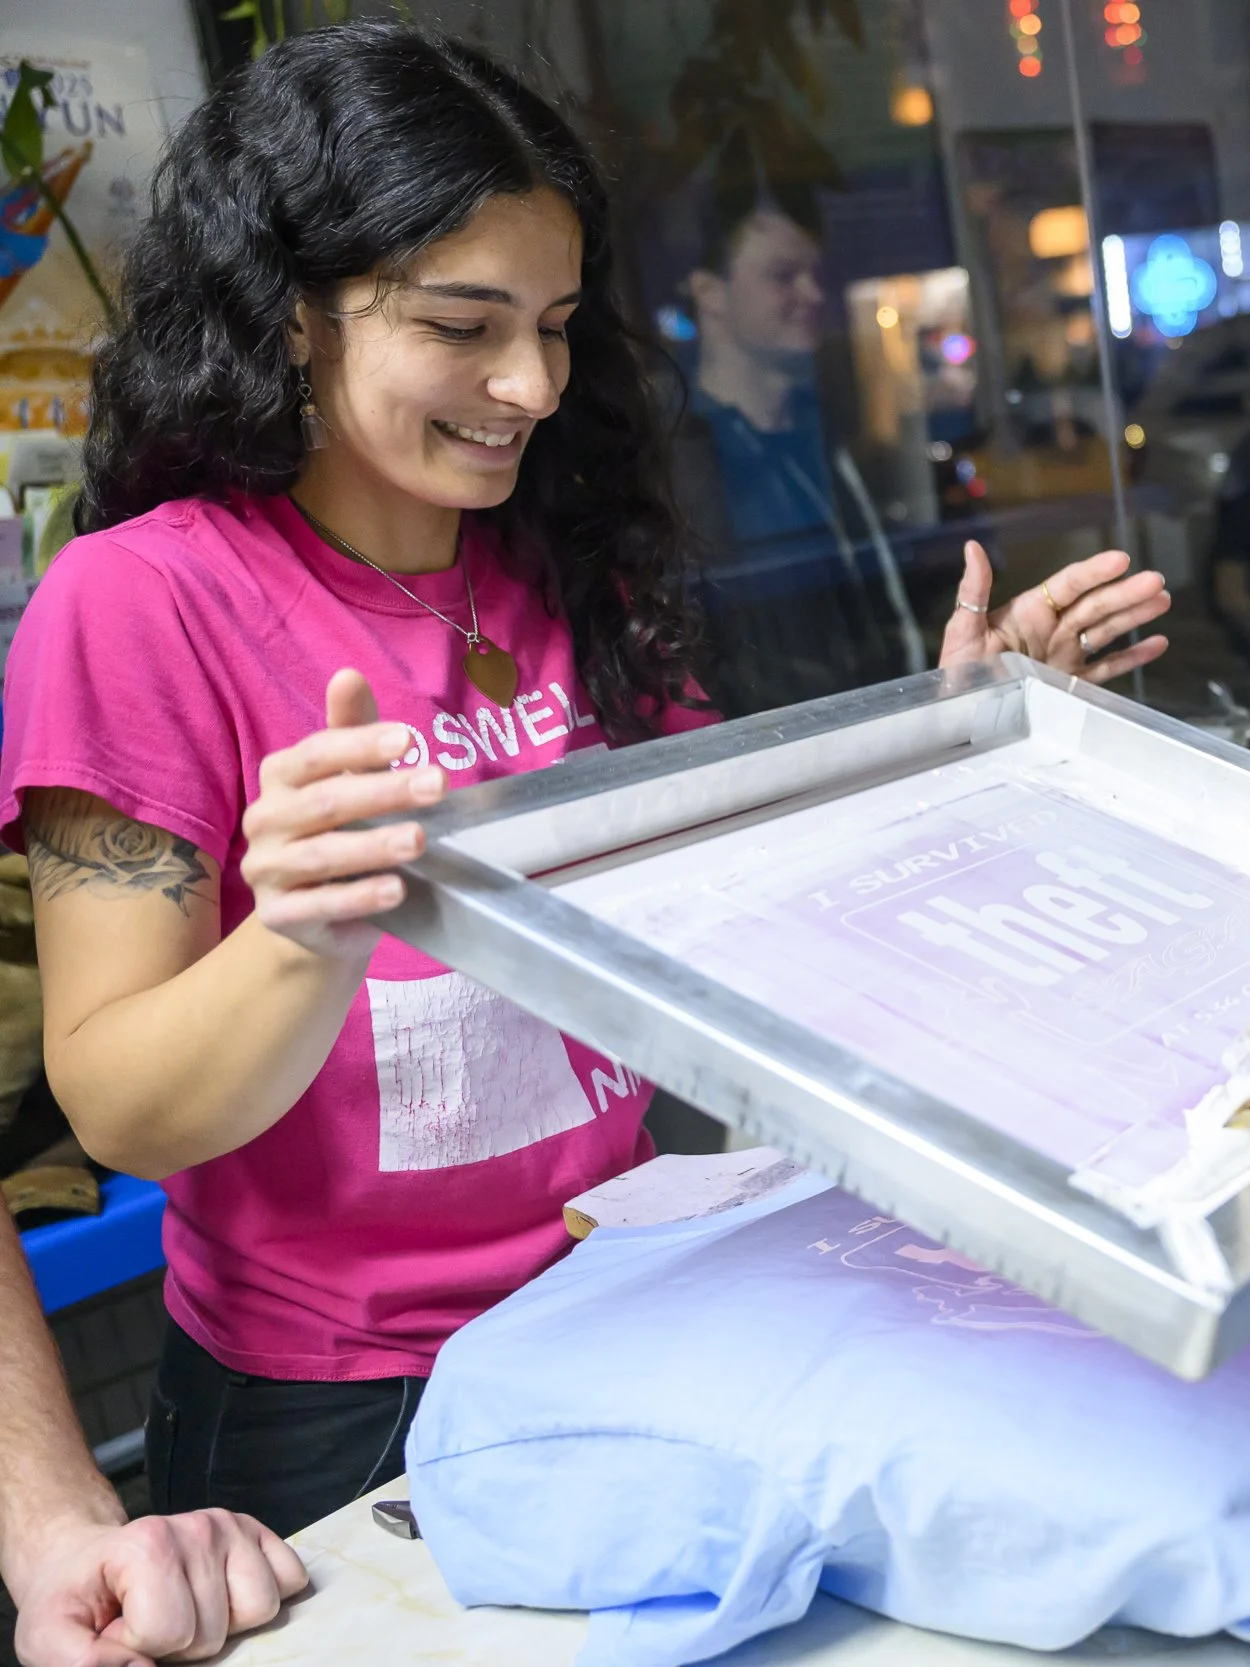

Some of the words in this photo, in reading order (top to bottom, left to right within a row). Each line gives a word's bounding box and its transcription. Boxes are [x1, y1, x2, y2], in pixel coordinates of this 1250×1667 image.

[807, 888, 842, 913] I
[849, 810, 1058, 895] SURVIVED
[896, 844, 1216, 987] theft
